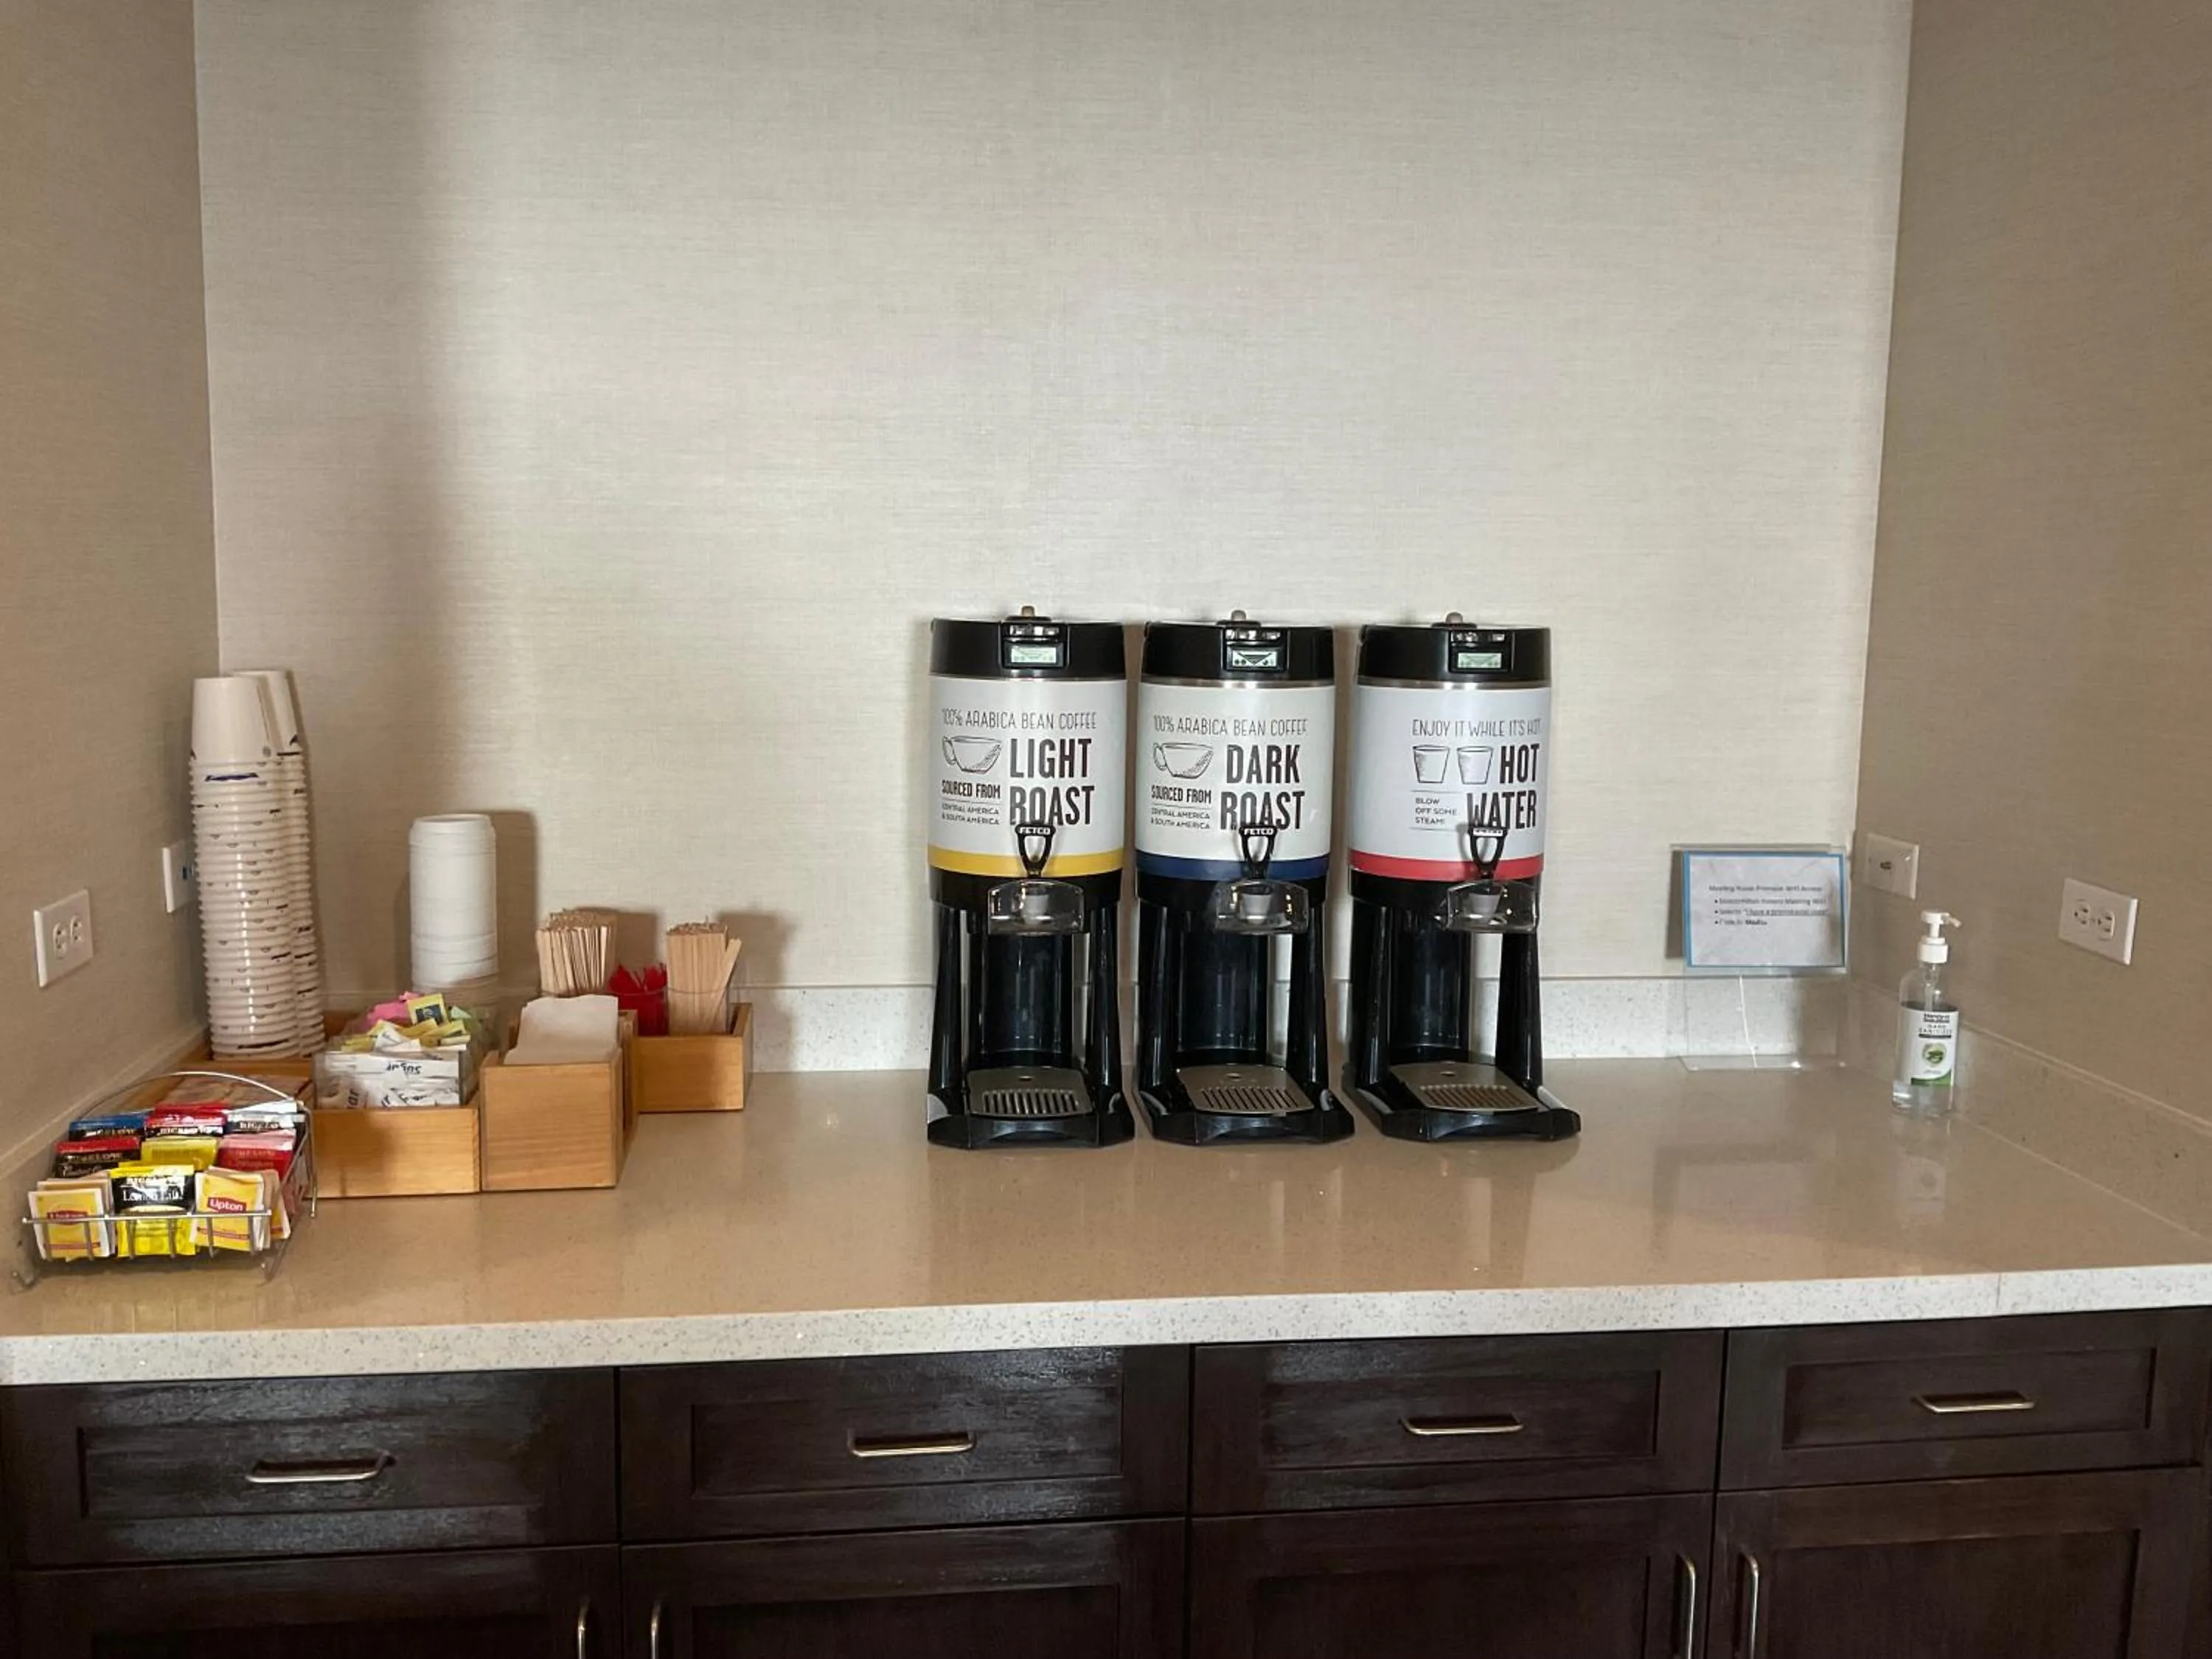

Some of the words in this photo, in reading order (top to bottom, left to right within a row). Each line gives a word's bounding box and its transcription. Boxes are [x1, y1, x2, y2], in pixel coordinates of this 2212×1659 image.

[942, 709, 962, 726] 100%
[965, 711, 1017, 729] ARABICA
[1021, 712, 1054, 729] BEAN
[1059, 712, 1097, 730] COFFEE
[1153, 714, 1174, 732] 100%
[1177, 717, 1228, 735] ARABICA
[1234, 719, 1266, 736] BEAN
[1270, 718, 1308, 736] COFFEE
[1412, 719, 1450, 737] ENJOY
[1455, 720, 1465, 737] IT
[1468, 720, 1505, 737] WHILE
[1509, 718, 1526, 737] IT'S
[1009, 738, 1092, 779] LIGHT
[1226, 745, 1300, 784] DARK
[1499, 742, 1540, 784] HOT
[942, 779, 973, 796] SOURCED
[975, 782, 1001, 799] FROM
[1151, 785, 1183, 801] SOURCED
[1186, 788, 1211, 804] FROM
[967, 807, 999, 815] AMERICA
[1009, 785, 1095, 826] ROAST
[1177, 811, 1210, 819] AMERICA
[1220, 790, 1305, 830] ROAST
[1432, 807, 1457, 815] SOME
[1466, 790, 1537, 830] WATER
[967, 817, 999, 825] AMERICA
[1176, 821, 1210, 829] AMERICA
[1020, 827, 1051, 835] FETCO
[209, 1197, 244, 1211] Lipton
